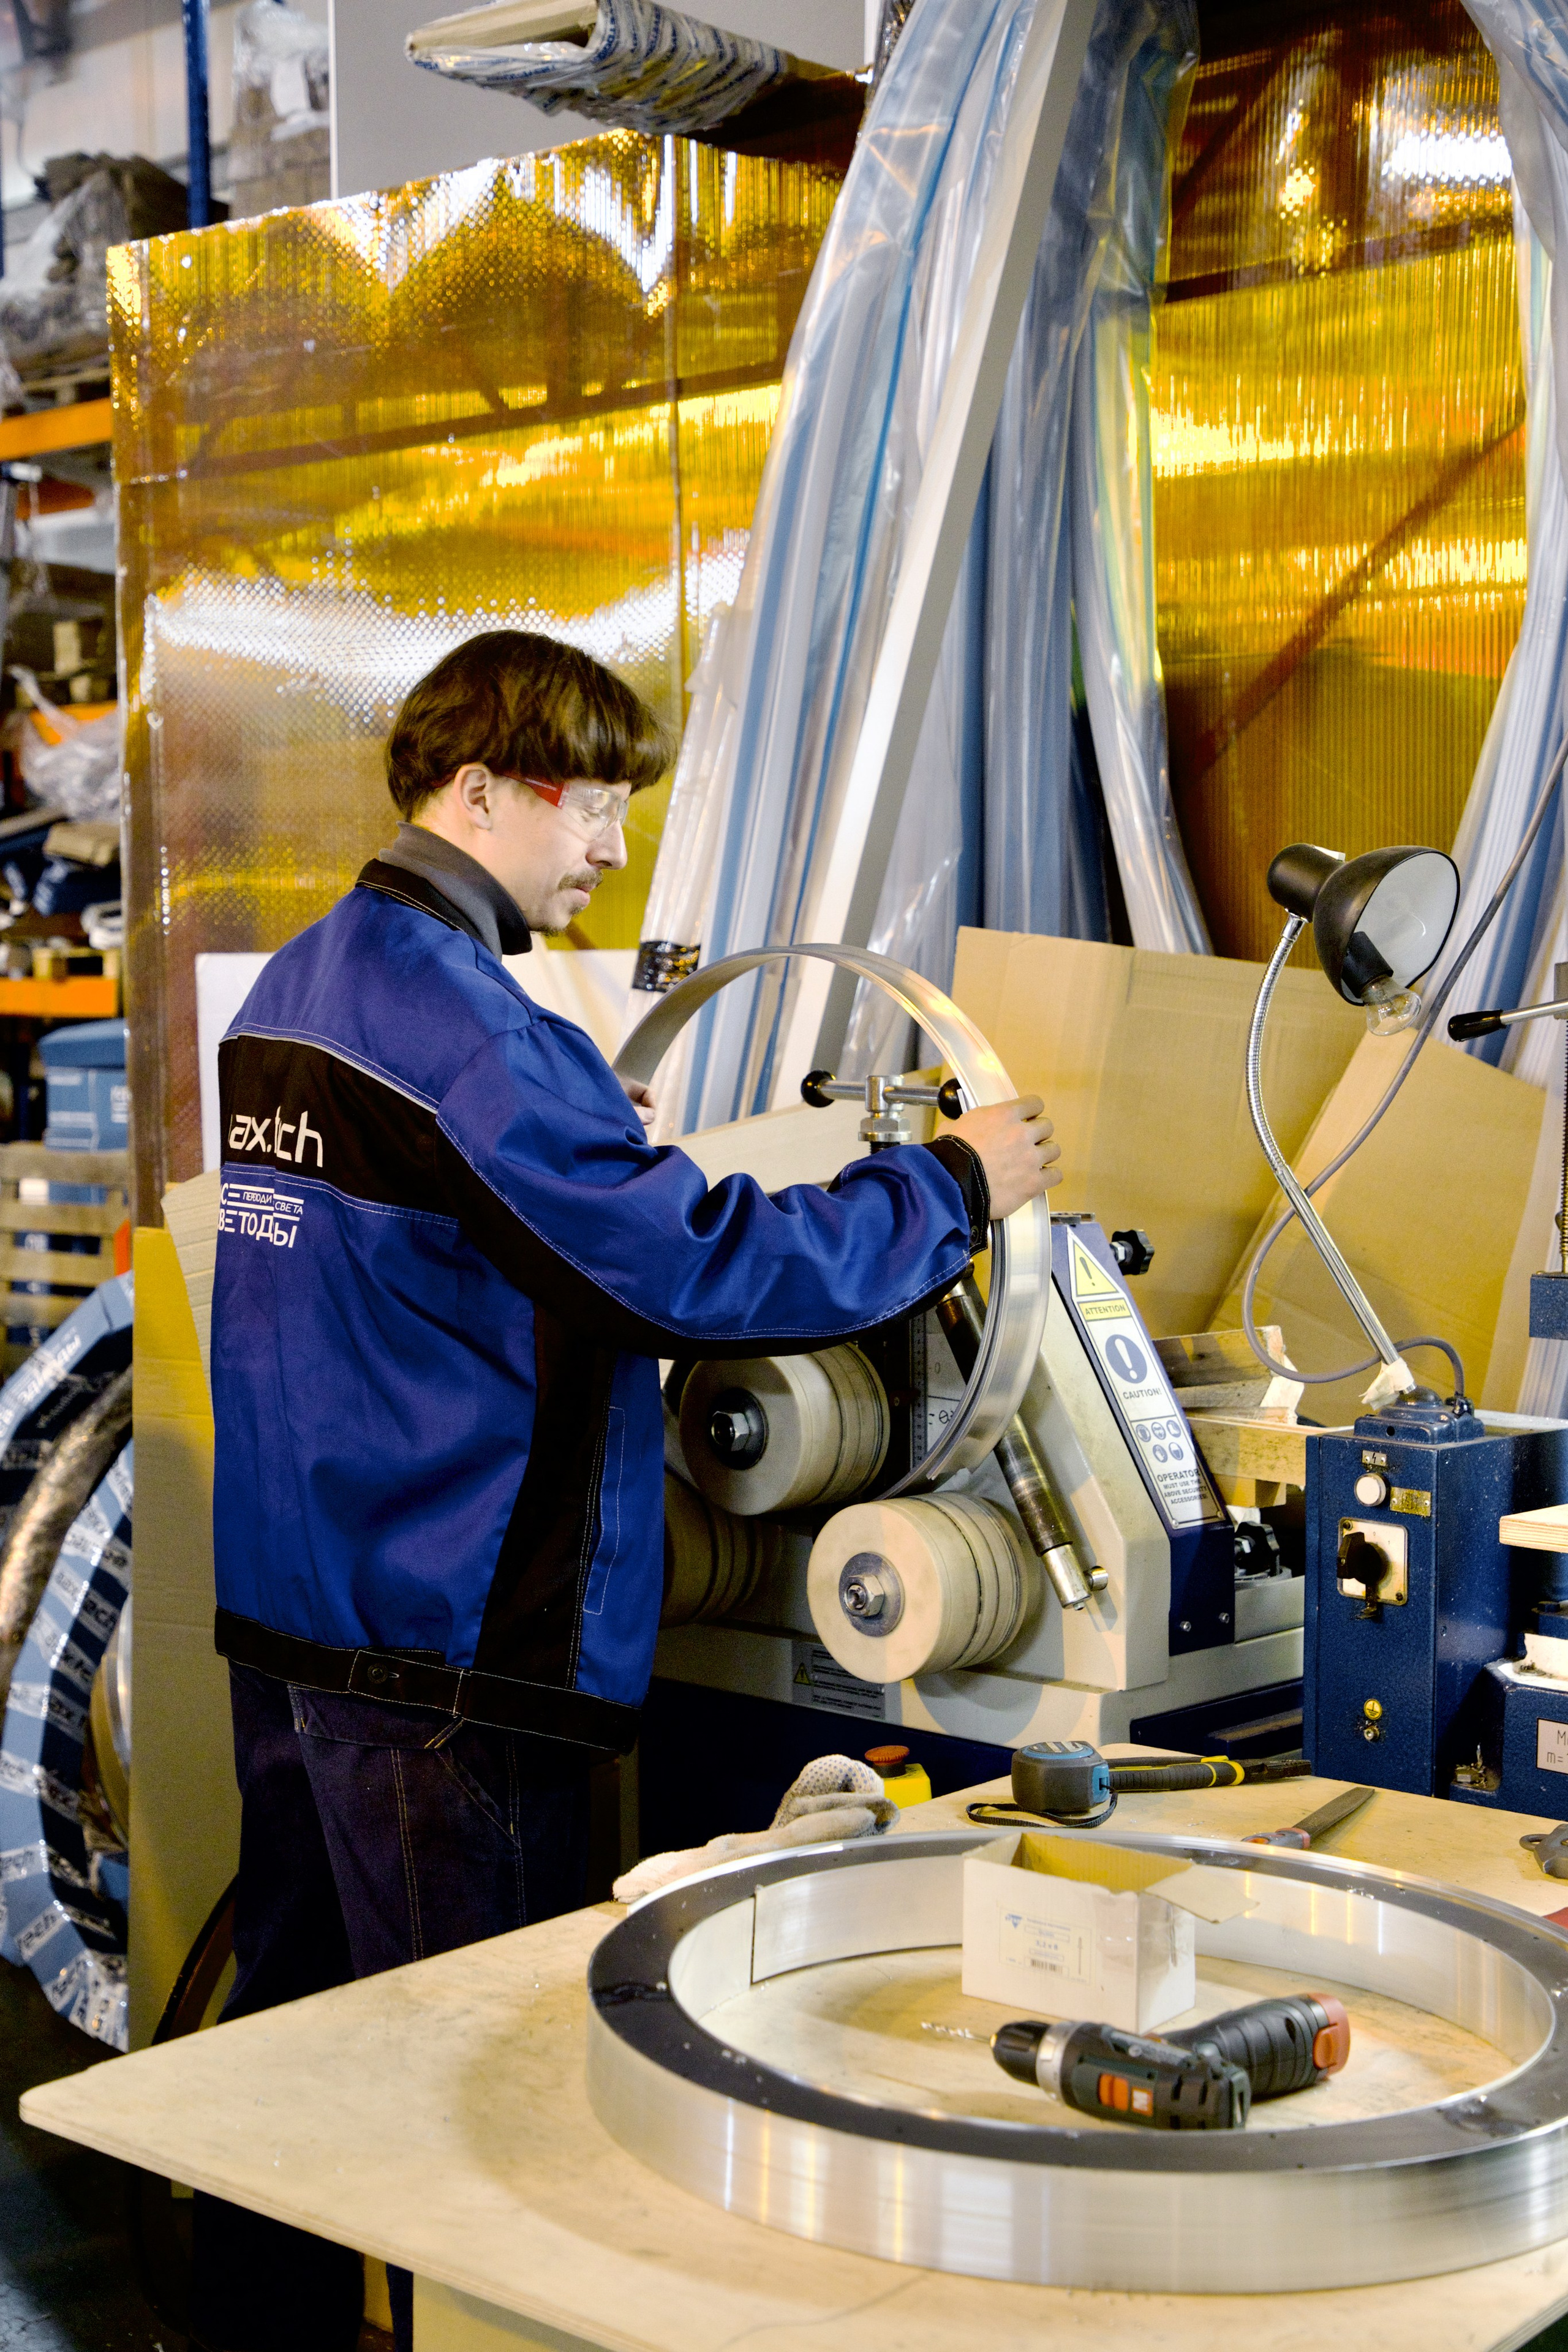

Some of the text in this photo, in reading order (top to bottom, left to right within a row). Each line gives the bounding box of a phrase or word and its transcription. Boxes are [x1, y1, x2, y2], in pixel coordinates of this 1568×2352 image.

[274, 1201, 303, 1215] СВЕТА
[1085, 1305, 1126, 1315] ATTENTION
[1123, 1387, 1163, 1400] CAUTION!
[1156, 1469, 1200, 1482] OPERATOR
[1556, 1729, 1568, 1746] M
